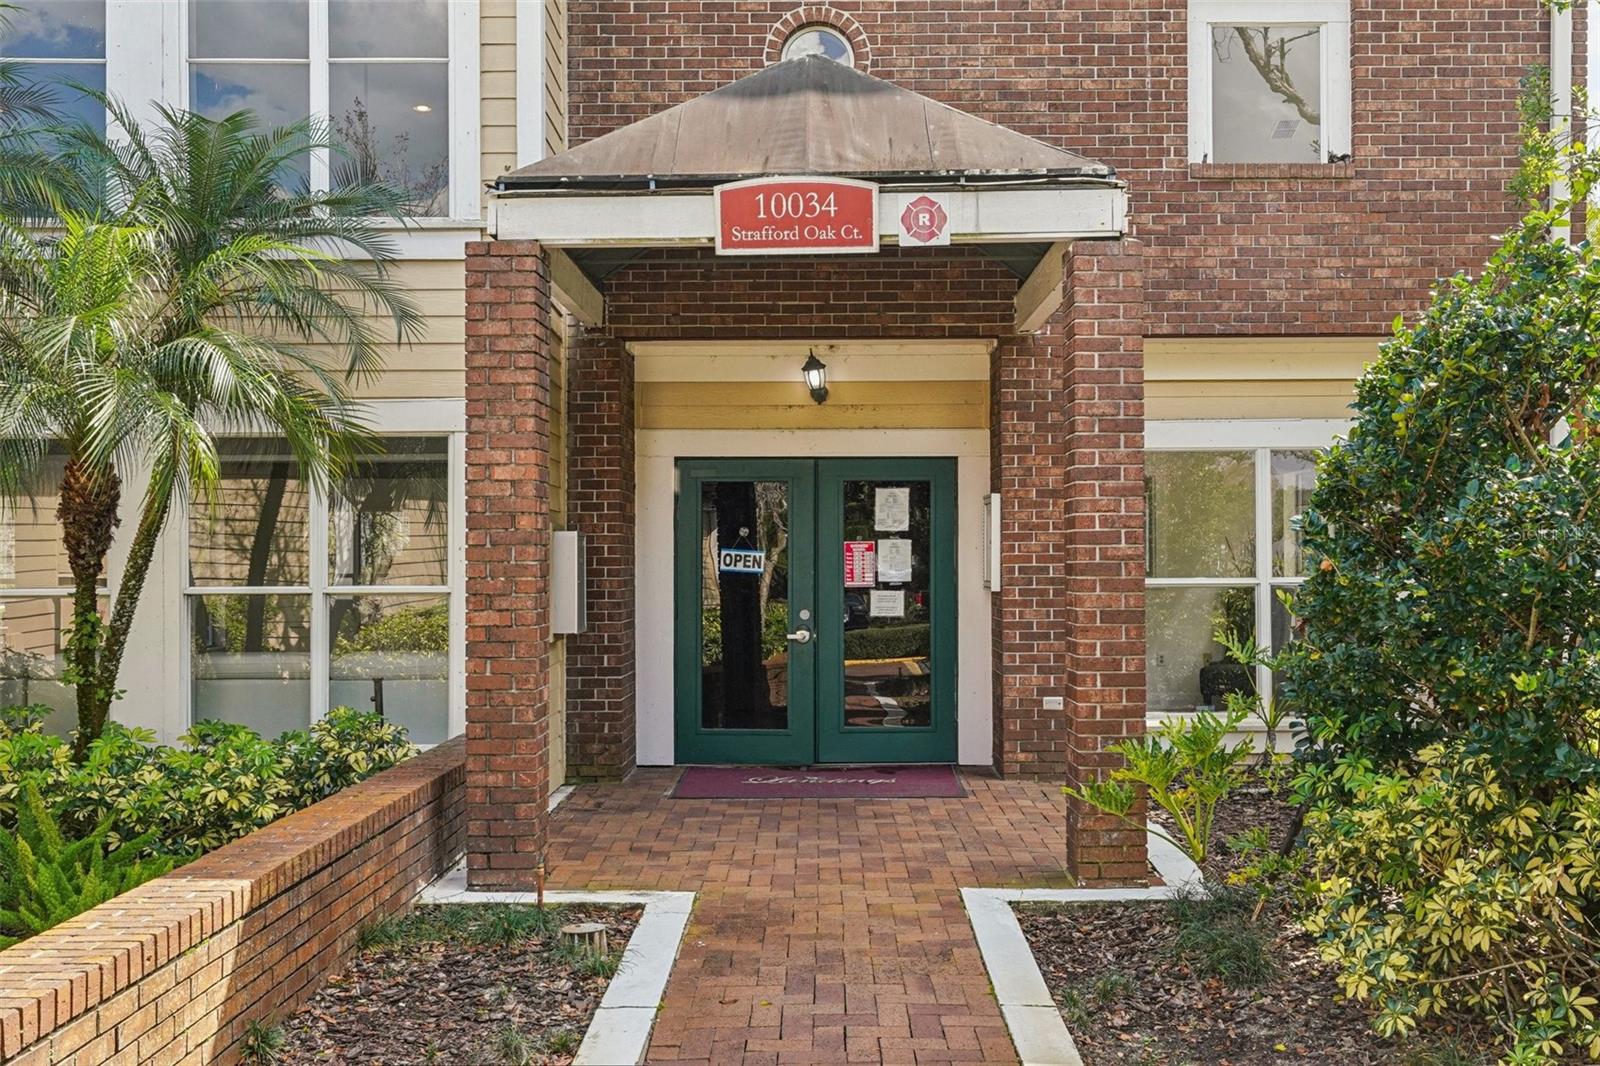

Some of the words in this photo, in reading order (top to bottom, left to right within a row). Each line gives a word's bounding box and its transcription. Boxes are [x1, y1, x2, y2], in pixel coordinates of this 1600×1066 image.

[755, 191, 838, 219] 10034
[918, 213, 931, 226] R
[731, 225, 800, 242] Strafford
[804, 224, 837, 240] Oak
[840, 224, 863, 240] Ct.
[723, 552, 763, 569] OPEN
